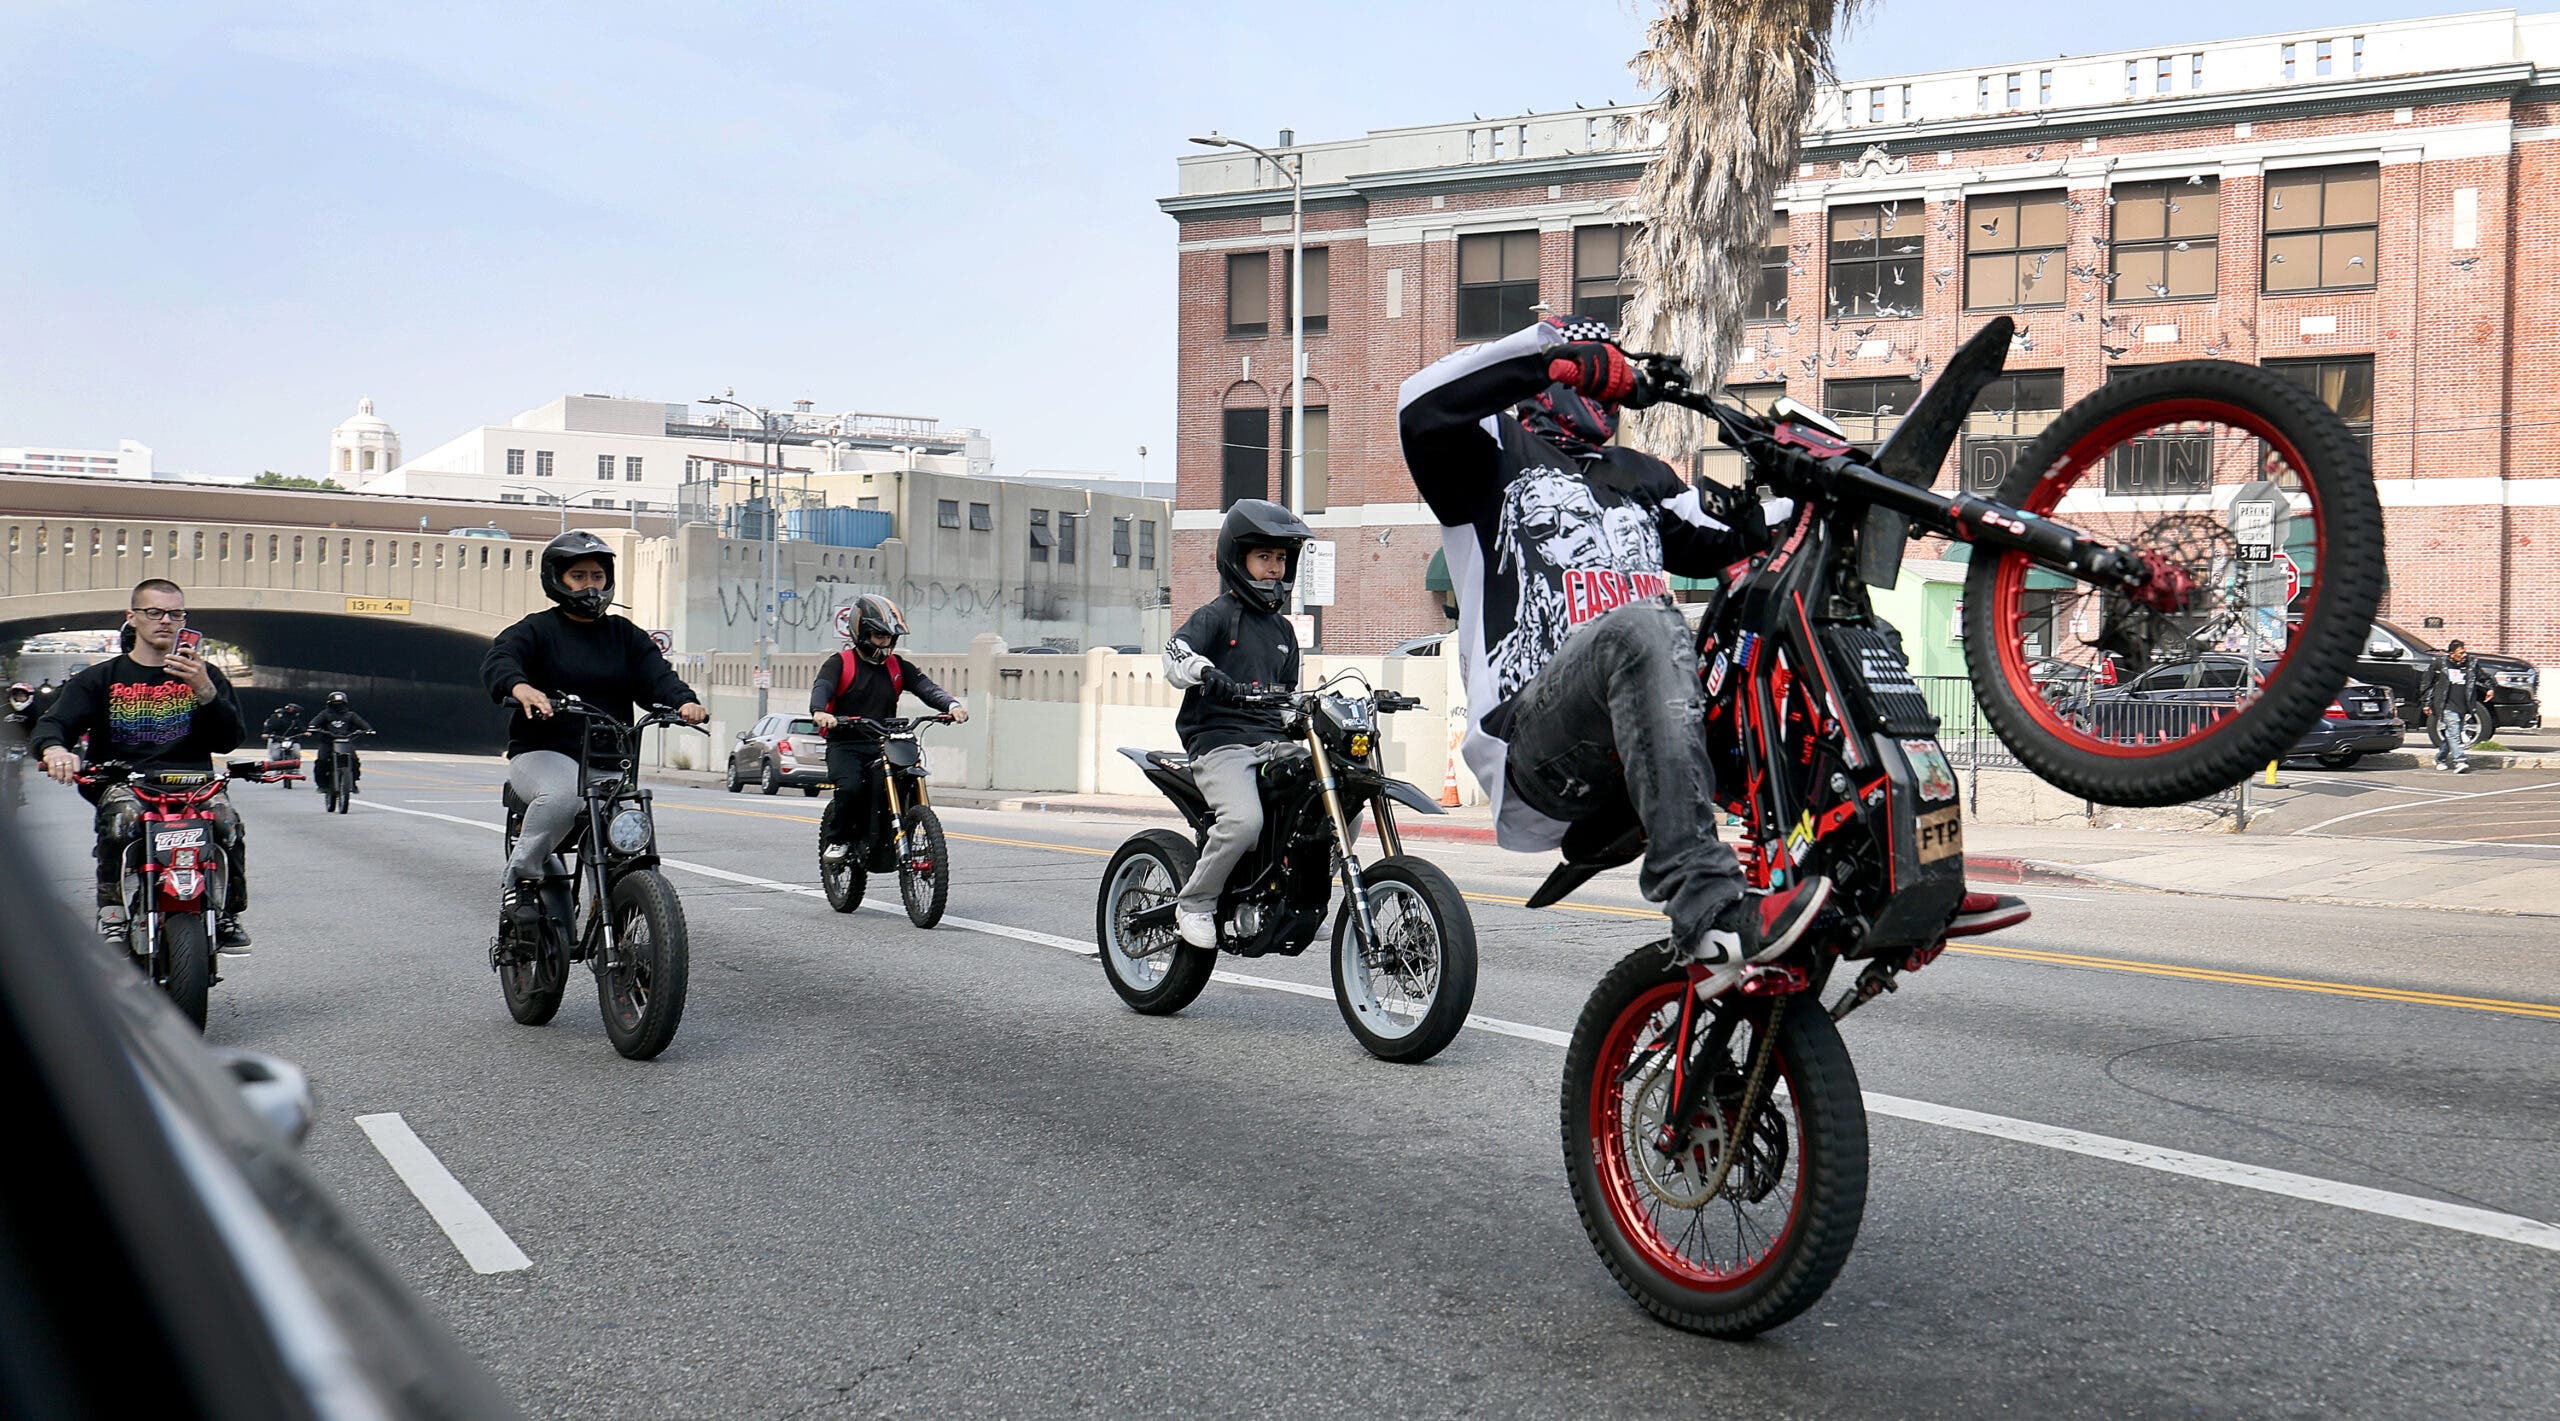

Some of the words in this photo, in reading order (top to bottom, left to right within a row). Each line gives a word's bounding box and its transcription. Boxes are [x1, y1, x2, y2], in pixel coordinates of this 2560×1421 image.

[2240, 507, 2270, 517] PARKING
[2248, 519, 2261, 529] LOT
[2240, 546, 2248, 558] 5
[1563, 569, 1632, 625] CASH
[351, 600, 378, 611] 13FT
[154, 827, 206, 852] 777
[1922, 819, 1960, 850] FTP
